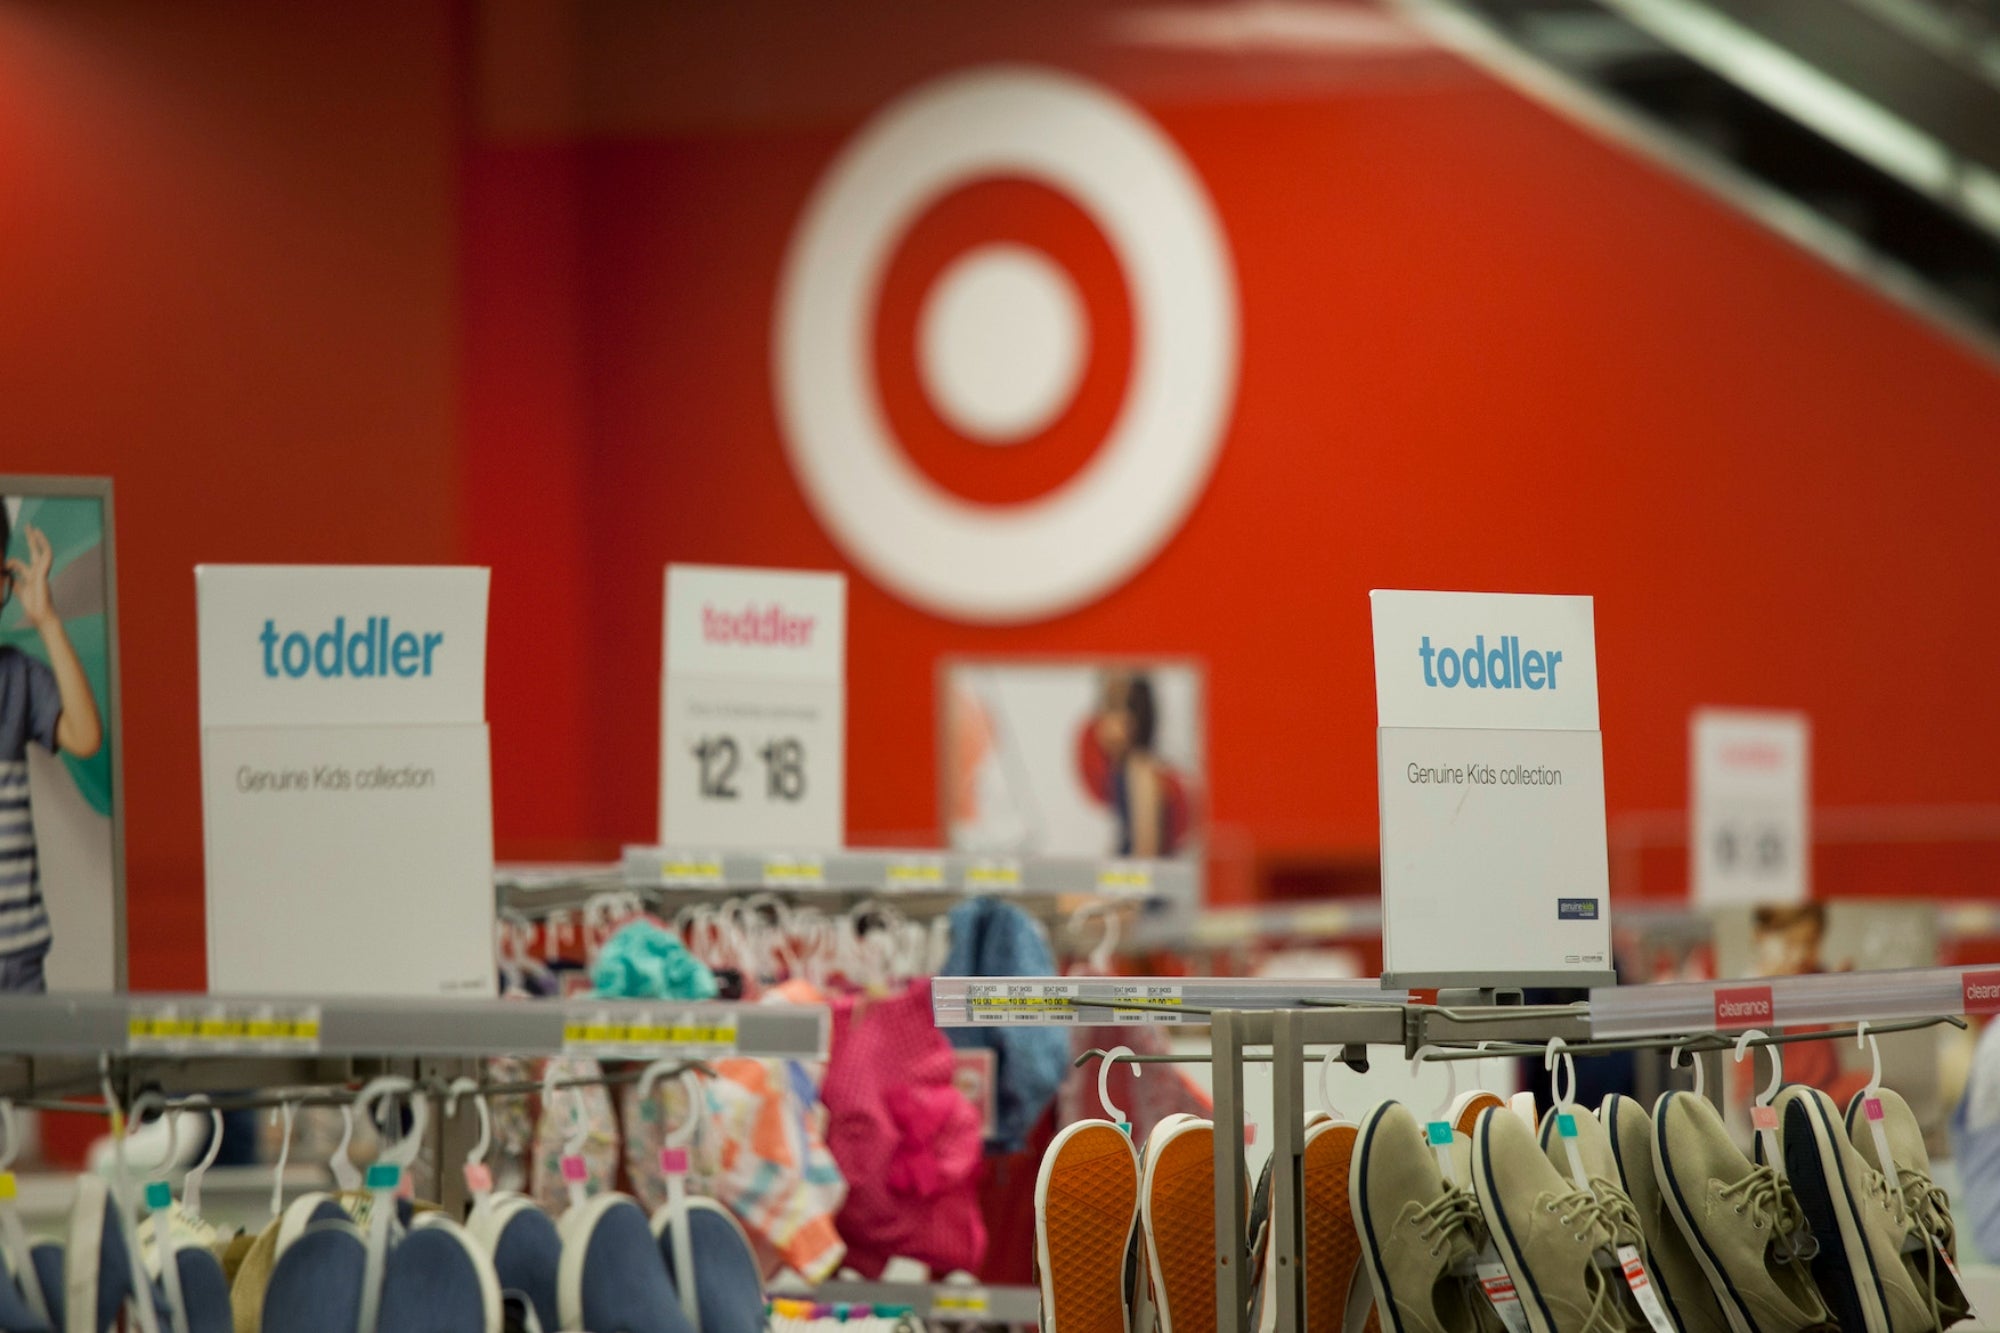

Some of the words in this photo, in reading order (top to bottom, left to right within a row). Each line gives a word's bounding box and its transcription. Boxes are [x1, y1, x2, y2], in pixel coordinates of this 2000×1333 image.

[702, 604, 815, 646] toddler
[259, 615, 443, 679] toddler
[1419, 634, 1563, 690] toddler
[236, 765, 308, 793] Genuine
[312, 765, 351, 792] Kids
[355, 764, 436, 790] collection
[691, 735, 739, 800] 12
[758, 736, 807, 802] 18
[1407, 762, 1464, 784] Genuine
[1467, 763, 1497, 785] Kids
[1500, 765, 1562, 785] collection
[1718, 999, 1769, 1018] clearance
